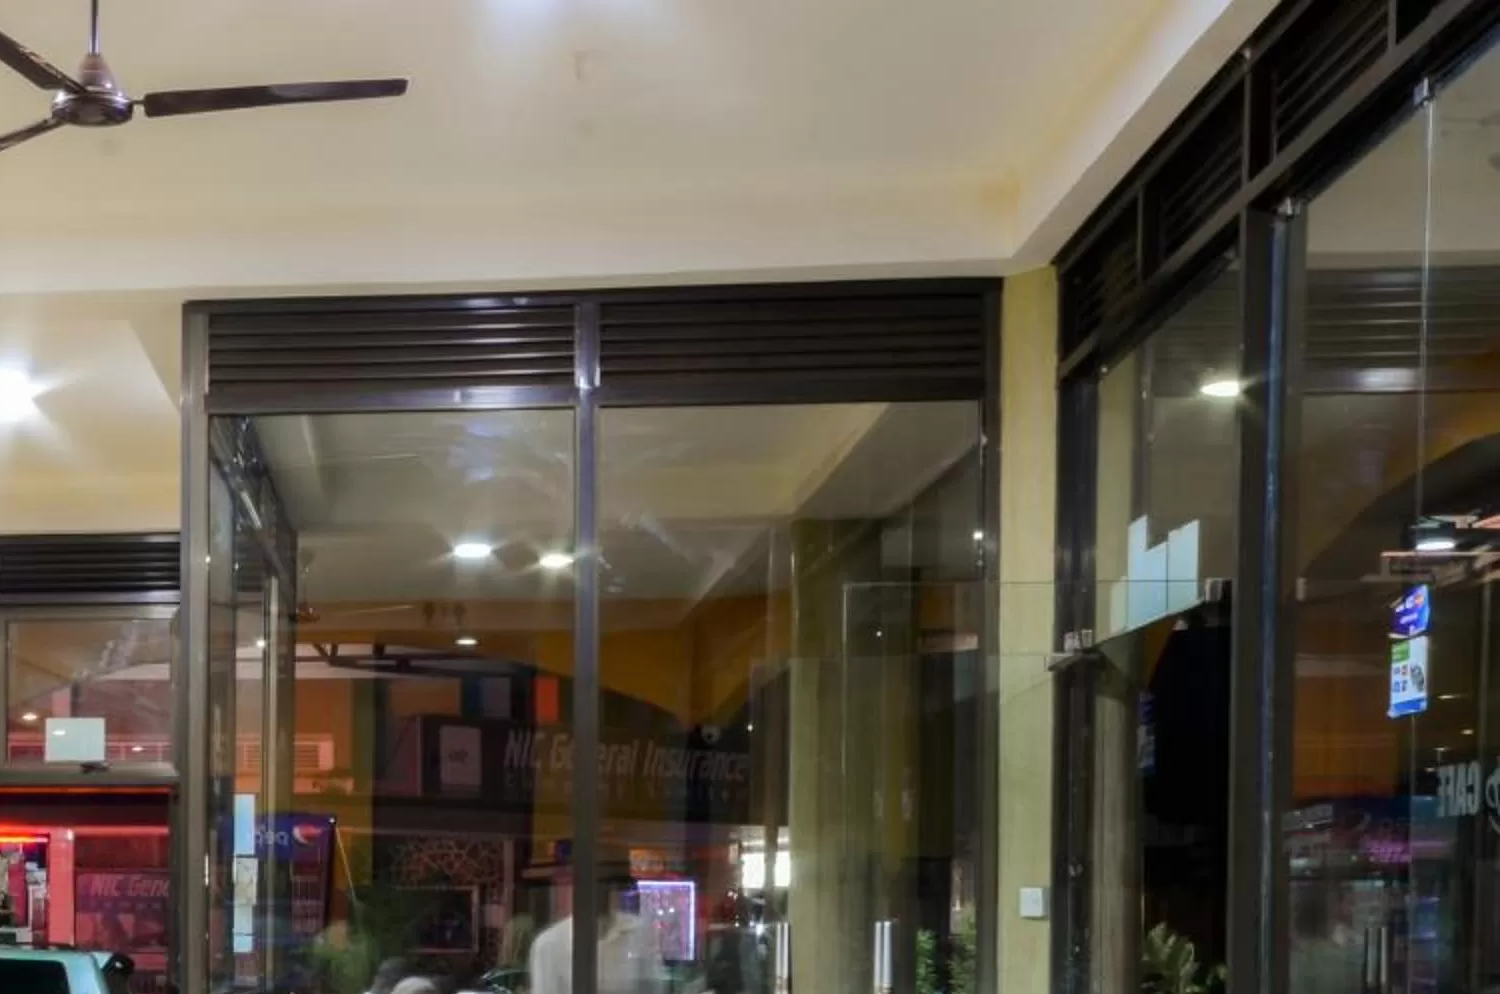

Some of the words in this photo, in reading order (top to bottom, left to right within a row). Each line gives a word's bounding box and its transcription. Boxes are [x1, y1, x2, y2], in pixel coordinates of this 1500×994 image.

[503, 729, 545, 769] NIC
[643, 739, 749, 783] Insurance
[90, 874, 125, 897] NIC
